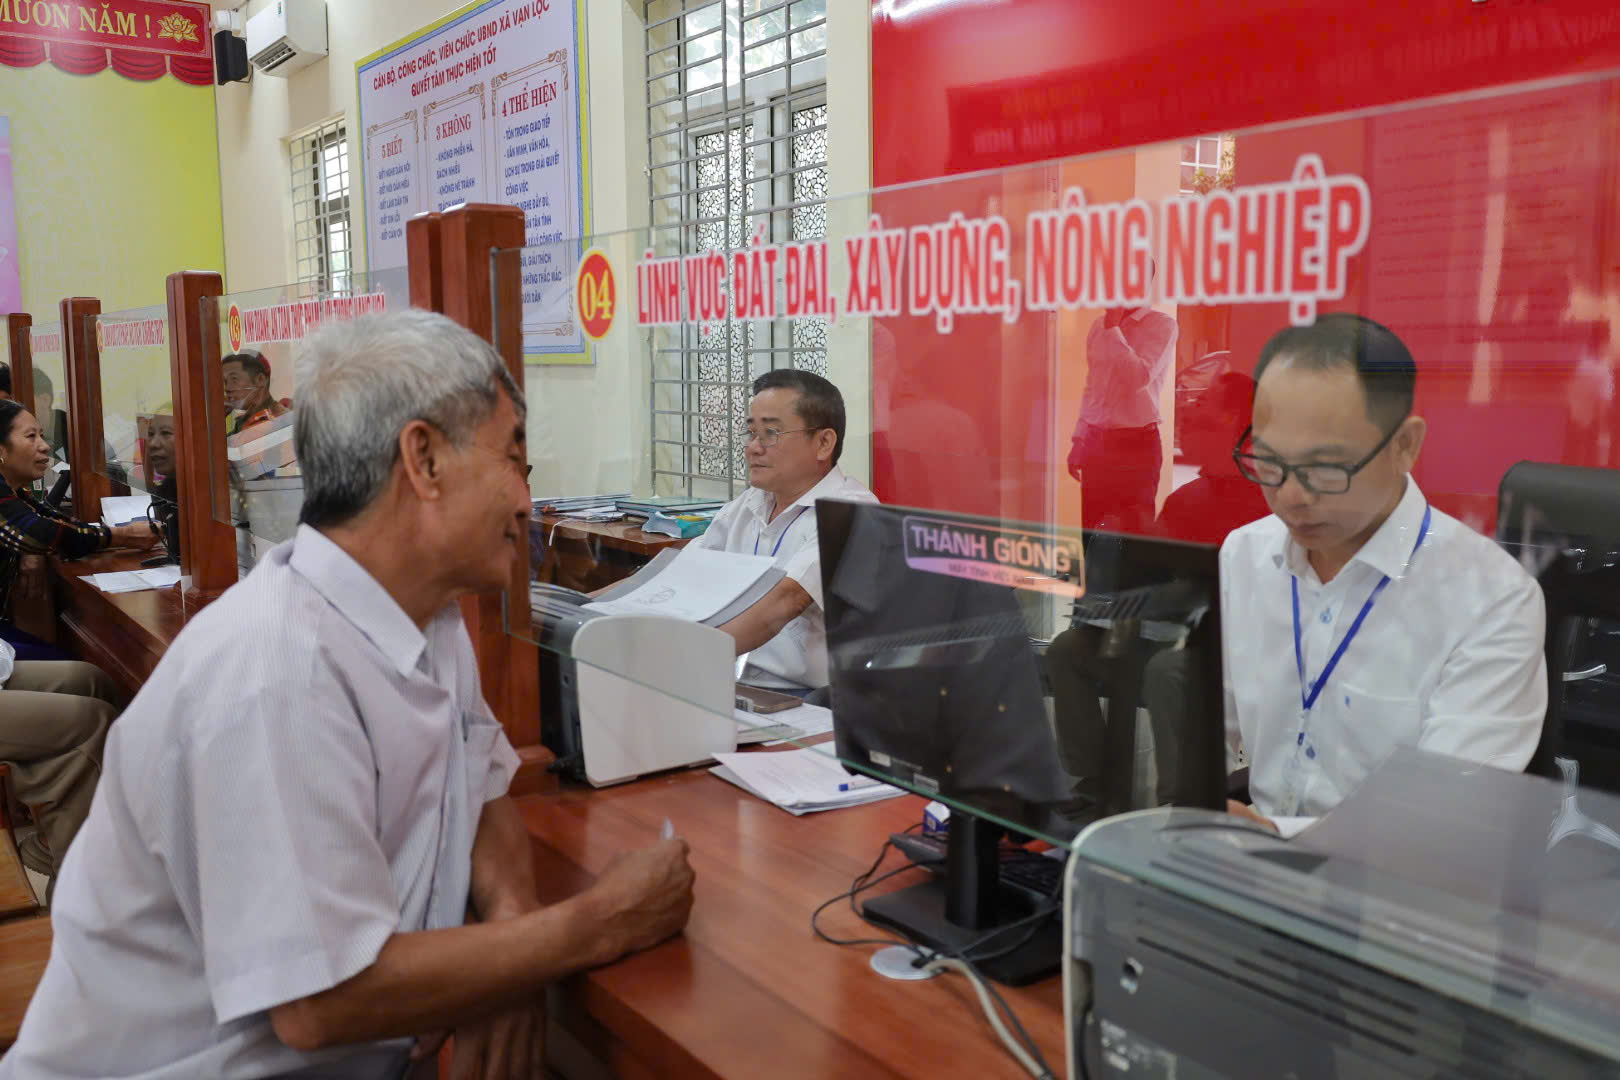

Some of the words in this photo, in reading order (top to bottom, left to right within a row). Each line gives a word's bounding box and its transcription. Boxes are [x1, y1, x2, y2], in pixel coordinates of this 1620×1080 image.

[78, 2, 138, 37] NĂM
[145, 14, 152, 39] !
[373, 72, 386, 90] CÁN
[398, 60, 417, 79] CÔNG
[439, 40, 454, 60] VIÊN
[455, 30, 476, 53] CHỨC
[477, 21, 498, 42] UBND
[499, 10, 511, 32] XÃ
[513, 4, 530, 28] VẠN
[411, 72, 430, 96] QUYẾT
[431, 70, 445, 89] TÂM
[446, 62, 464, 83] THỰC
[465, 53, 482, 75] HIỆN
[483, 42, 497, 66] TỐT
[501, 102, 507, 117] 4
[508, 82, 529, 115] THỂ
[531, 80, 558, 108] HIỆN
[381, 145, 386, 159] 5
[387, 134, 403, 156] BIẾT
[435, 126, 441, 141] 3
[442, 114, 472, 139] KHÔNG
[684, 248, 728, 337] VỰC
[733, 224, 778, 319] ĐẤT
[784, 242, 837, 323] ĐAI,
[845, 215, 904, 314] XÂY
[911, 212, 1020, 333] DỰNG,
[1027, 187, 1153, 310] NÔNG
[1164, 155, 1371, 326] NGHIỆP
[581, 270, 612, 321] 04
[911, 525, 987, 559] THÁNH
[993, 536, 1071, 574] GIÓNG
